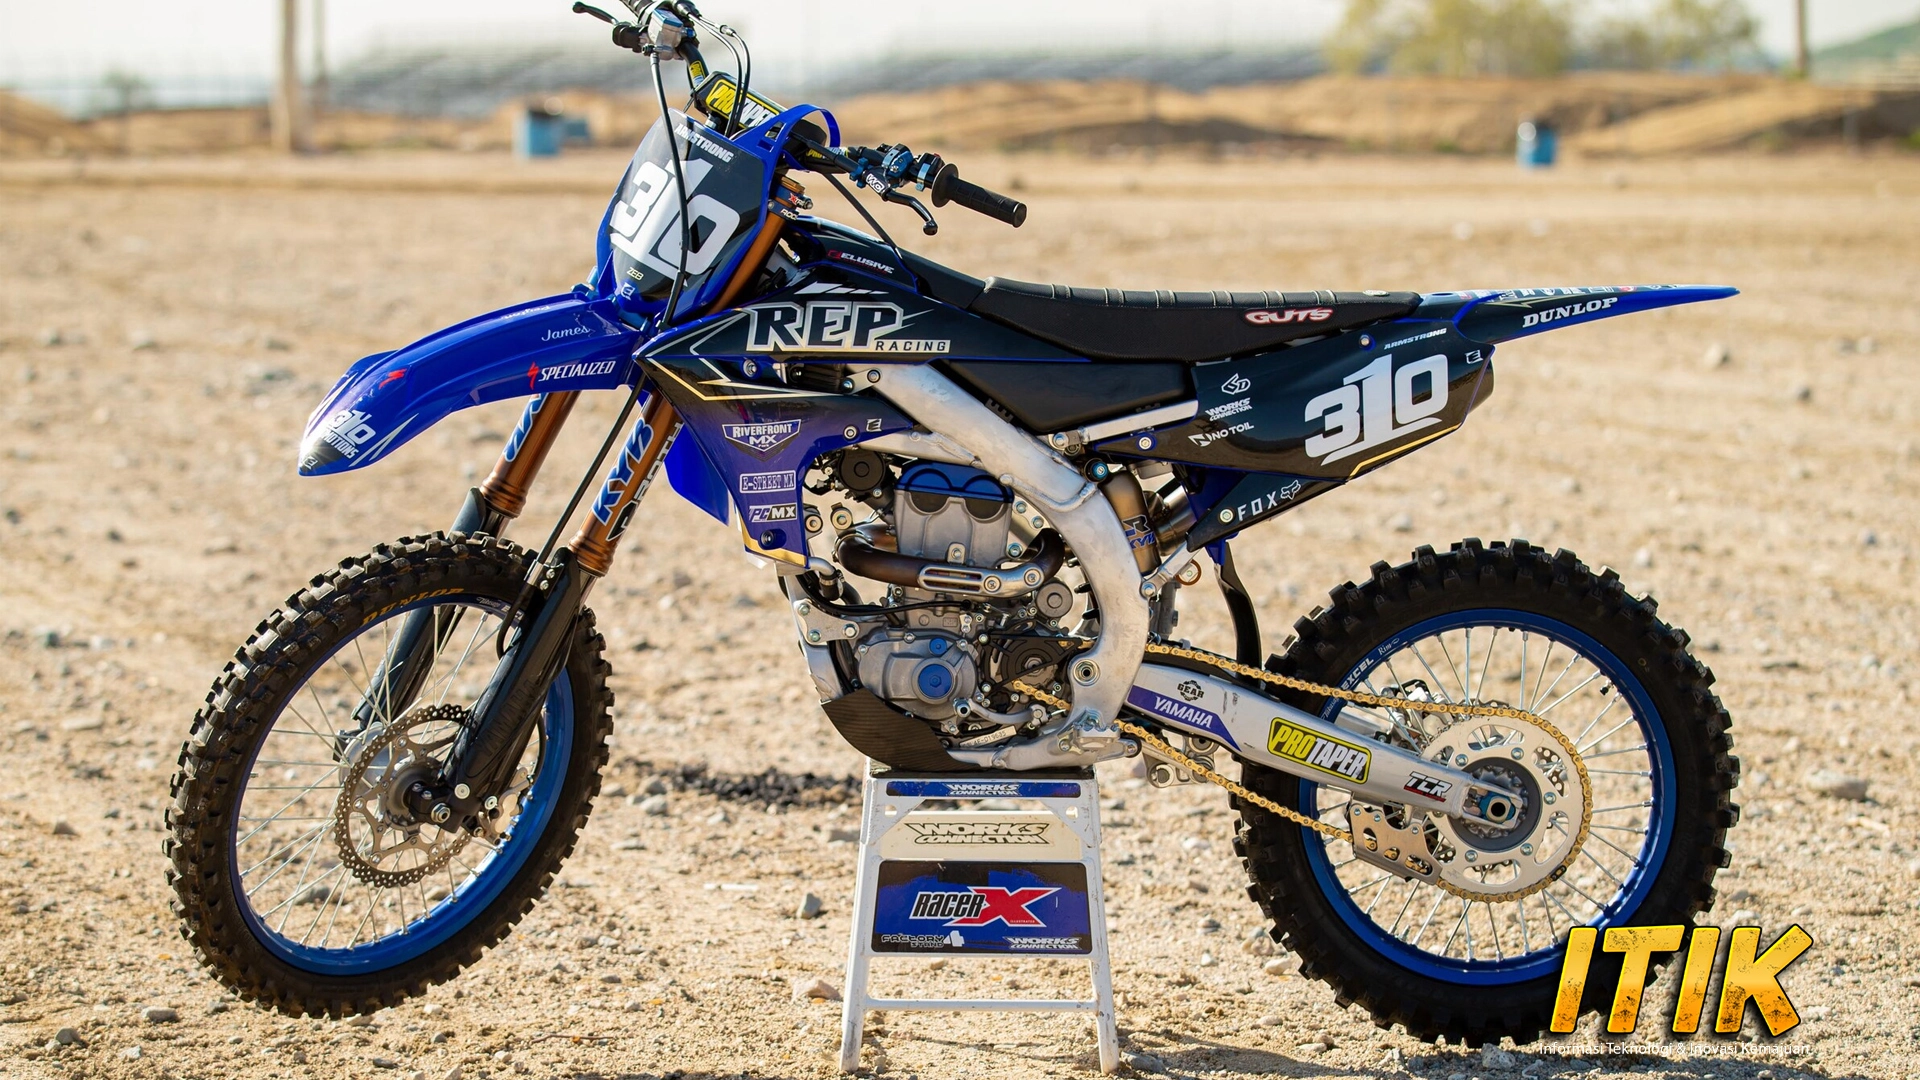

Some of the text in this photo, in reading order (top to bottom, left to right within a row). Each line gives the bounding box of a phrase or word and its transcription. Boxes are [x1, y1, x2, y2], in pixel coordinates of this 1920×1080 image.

[674, 123, 734, 163] ARMSTRONG
[609, 158, 740, 282] 310
[841, 252, 894, 274] ELUSIVE
[1245, 306, 1333, 324] GUTS
[1522, 297, 1618, 328] DUNLOP
[541, 325, 591, 342] James
[746, 301, 904, 350] REP
[874, 339, 949, 353] RACING
[1384, 327, 1447, 350] ARMSTRONG
[538, 360, 616, 382] SPECIALIZED
[1205, 397, 1251, 416] WORKS
[1209, 405, 1253, 422] CONNECTION
[1304, 353, 1449, 466] 310
[732, 423, 793, 438] RIVERFRONT
[749, 434, 777, 445] MX
[591, 417, 654, 526] KYB
[1237, 491, 1278, 522] FOX
[1341, 658, 1374, 690] EXCEL
[1177, 683, 1204, 699] GEAR
[1154, 695, 1214, 729] YAMAHA
[1272, 724, 1368, 780] PROTAPER
[945, 783, 1021, 791] WORKS
[1406, 771, 1452, 797] TCR
[905, 823, 1050, 835] WORKS
[914, 834, 1050, 844] CONNECTION
[1004, 936, 1080, 944] WORKS
